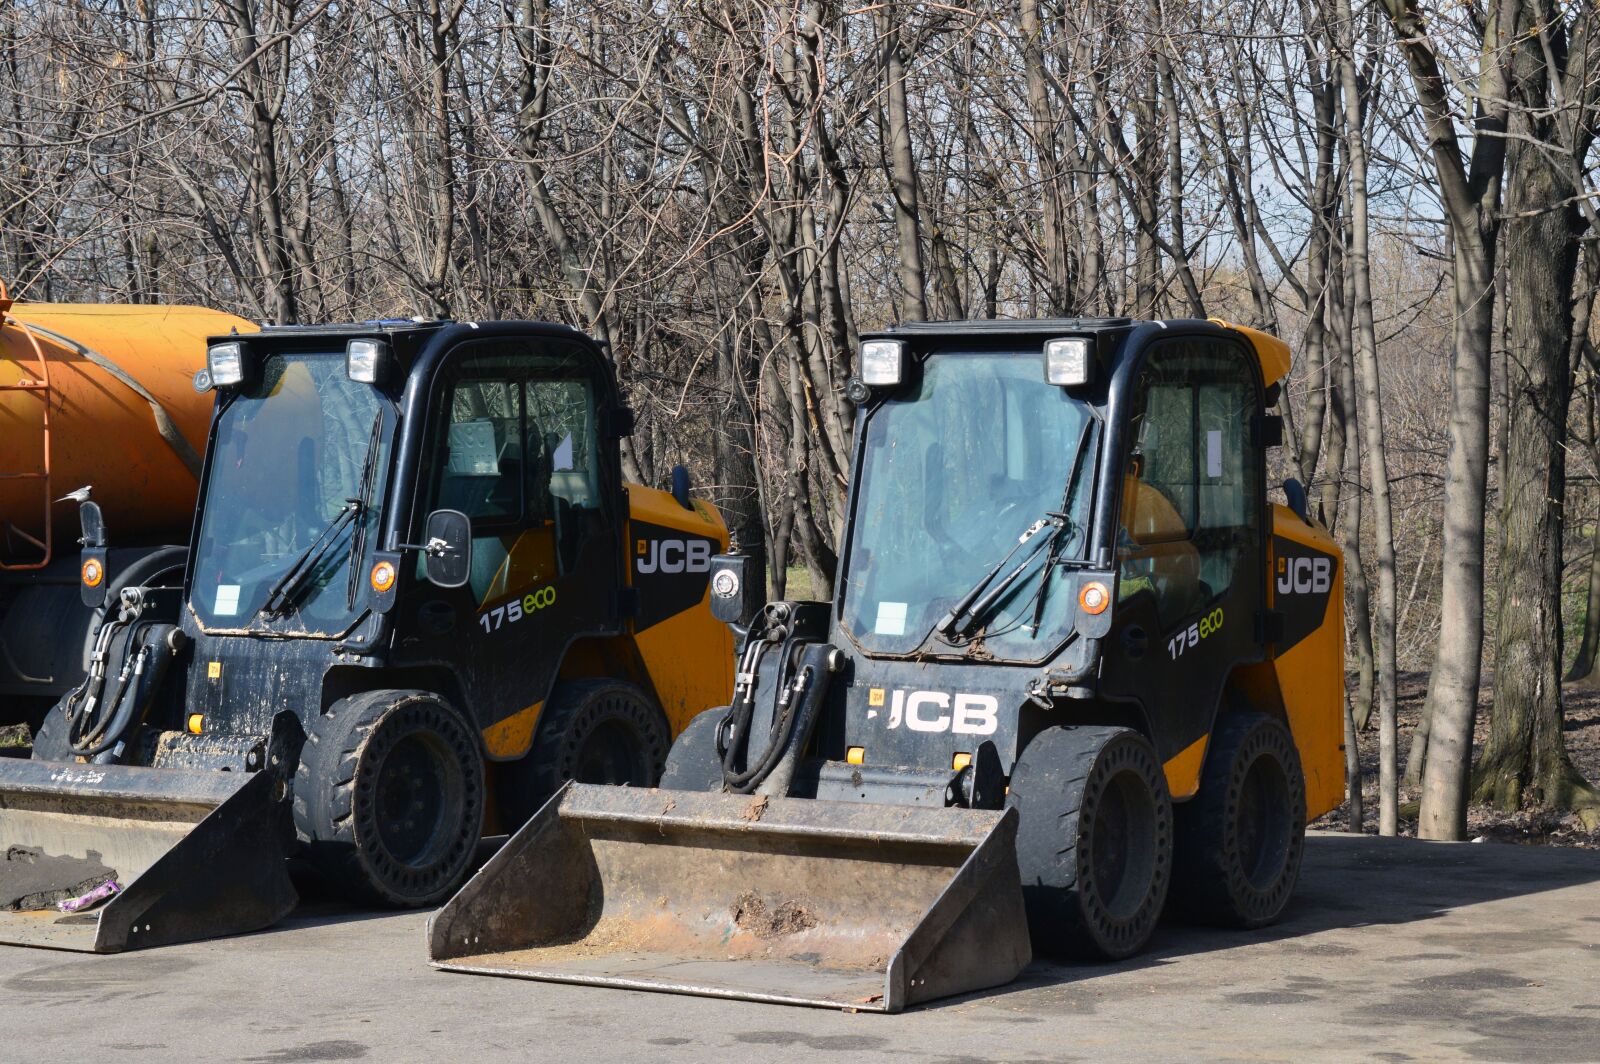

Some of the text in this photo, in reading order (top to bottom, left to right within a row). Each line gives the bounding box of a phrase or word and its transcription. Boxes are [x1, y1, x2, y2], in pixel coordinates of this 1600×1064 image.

[637, 540, 711, 574] JCB
[1277, 557, 1331, 594] JCB
[868, 689, 999, 735] JCB
